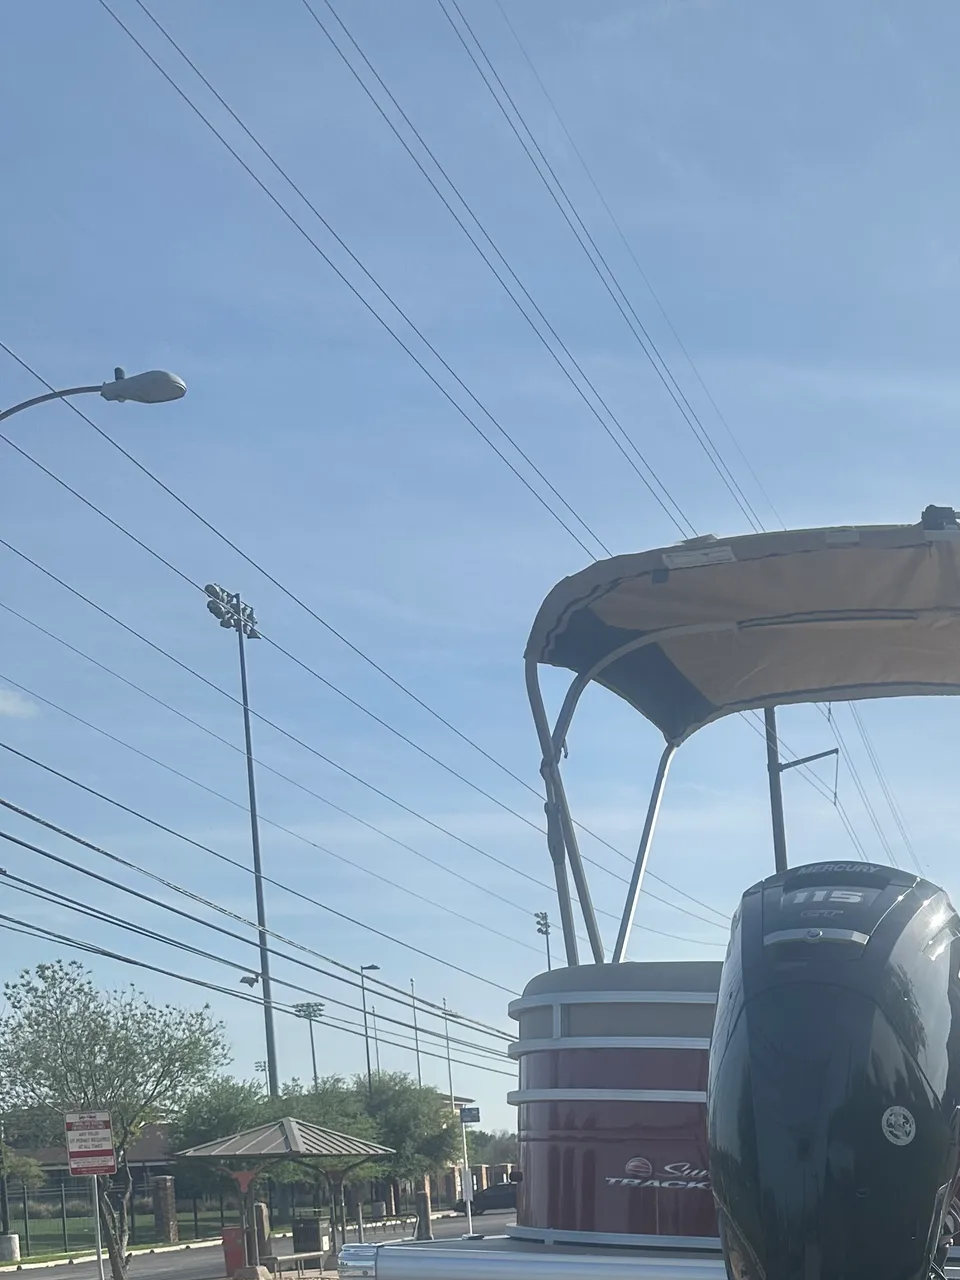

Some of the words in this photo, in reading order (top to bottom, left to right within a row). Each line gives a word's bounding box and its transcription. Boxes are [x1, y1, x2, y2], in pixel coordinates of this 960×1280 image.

[798, 864, 880, 875] MERCURY
[793, 890, 862, 904] 115
[605, 1177, 713, 1190] TRACK
